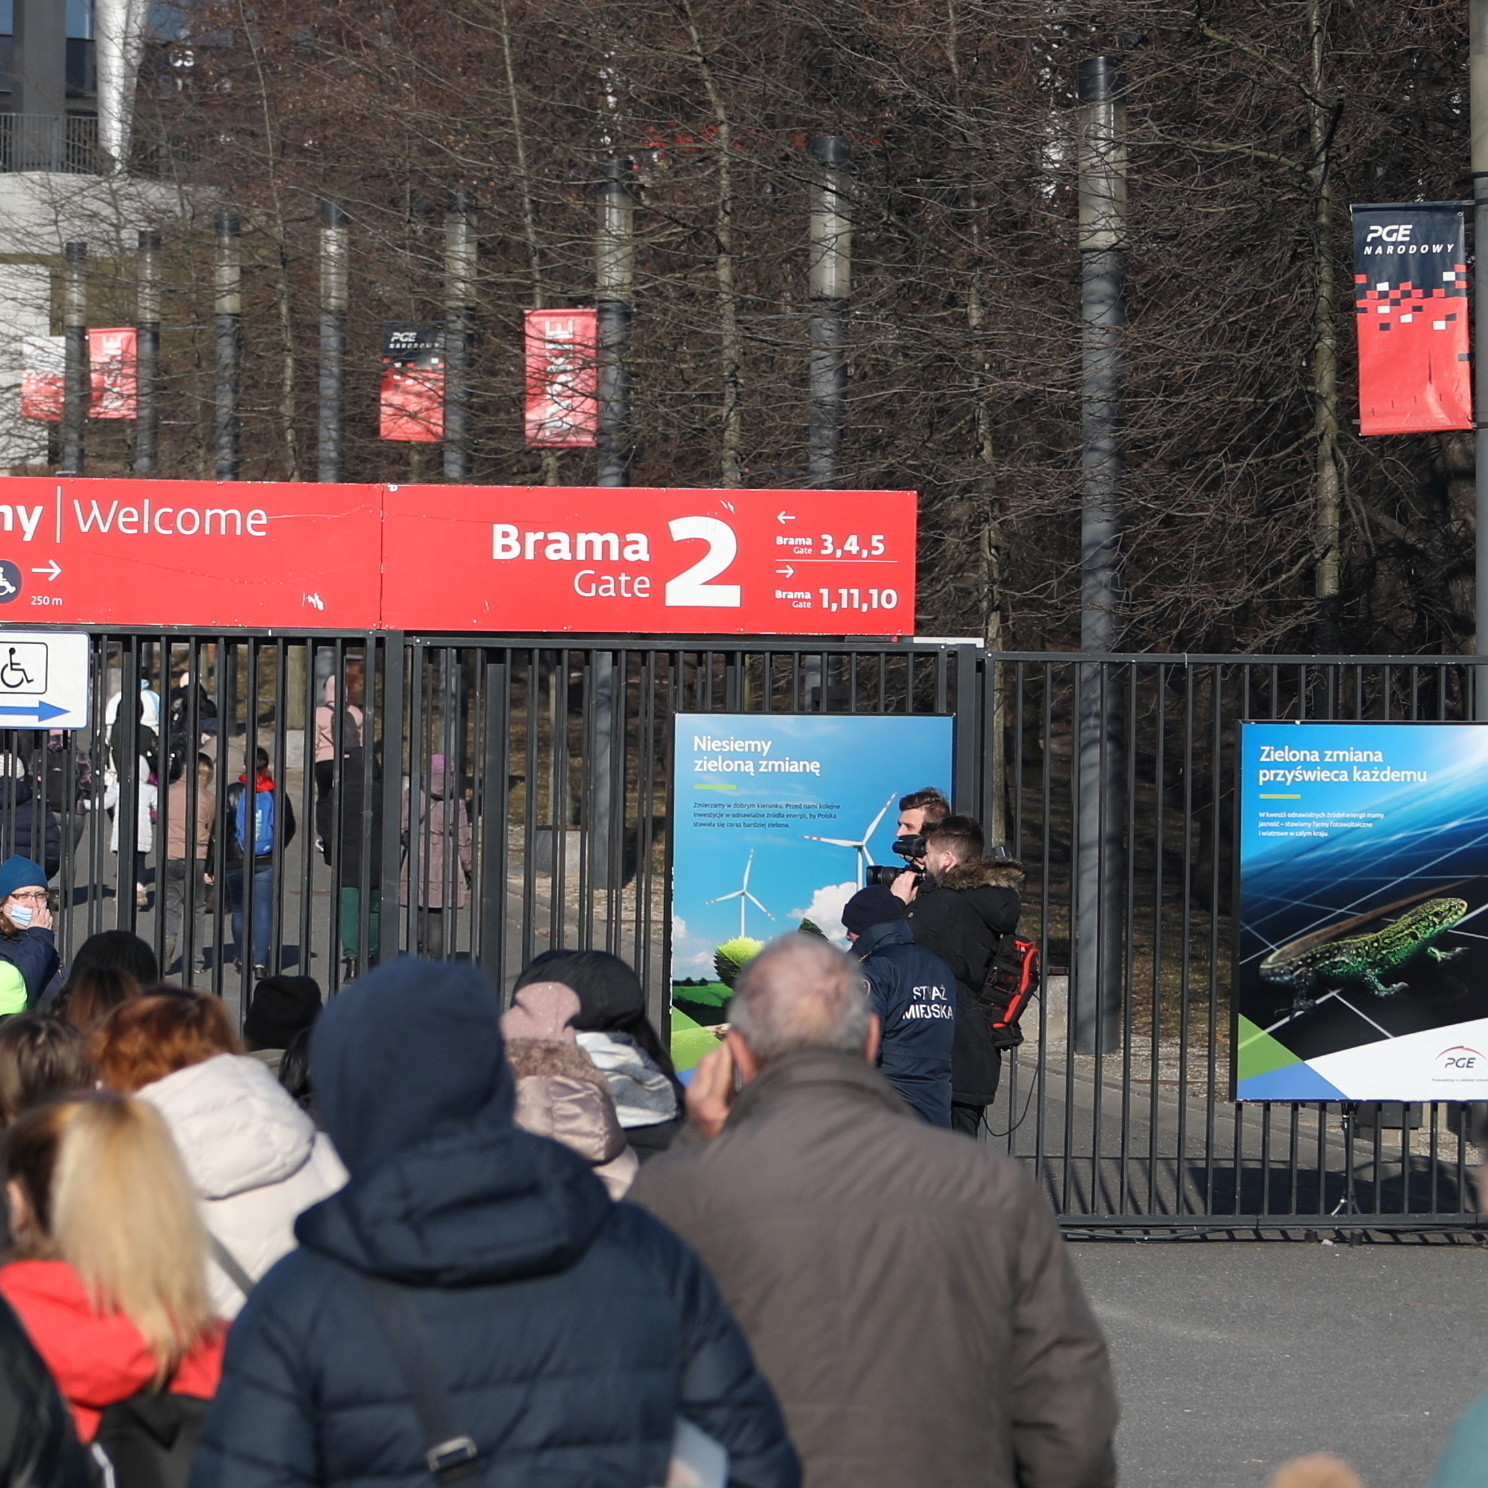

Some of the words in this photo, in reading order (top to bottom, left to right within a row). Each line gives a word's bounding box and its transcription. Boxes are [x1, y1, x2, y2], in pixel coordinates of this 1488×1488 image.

[1366, 224, 1413, 243] PGE
[1364, 243, 1454, 255] NARODOWY
[391, 332, 417, 342] PGE
[73, 498, 268, 537] Welcome
[775, 535, 812, 546] Brama
[820, 534, 886, 559] 3,4,5
[793, 546, 812, 555] Gate
[492, 523, 650, 562] Brama
[665, 515, 742, 608] 2
[573, 569, 651, 599] Gate
[31, 595, 50, 606] 250
[52, 598, 63, 606] m
[775, 589, 812, 600] Brama
[819, 587, 898, 613] 1,11,10
[792, 600, 812, 609] Gate
[693, 735, 772, 757] Niesiemy
[1259, 745, 1320, 763] Zielona
[1324, 747, 1384, 763] zmiana
[694, 755, 755, 776] zieloną
[758, 756, 821, 776] zmianę
[1258, 765, 1349, 786] przyświeca
[1352, 766, 1428, 782] każdemu
[693, 802, 725, 810] Zmierzamy
[733, 802, 755, 810] dobrym
[819, 803, 840, 811] kolejne
[1444, 1057, 1477, 1069] PGE
